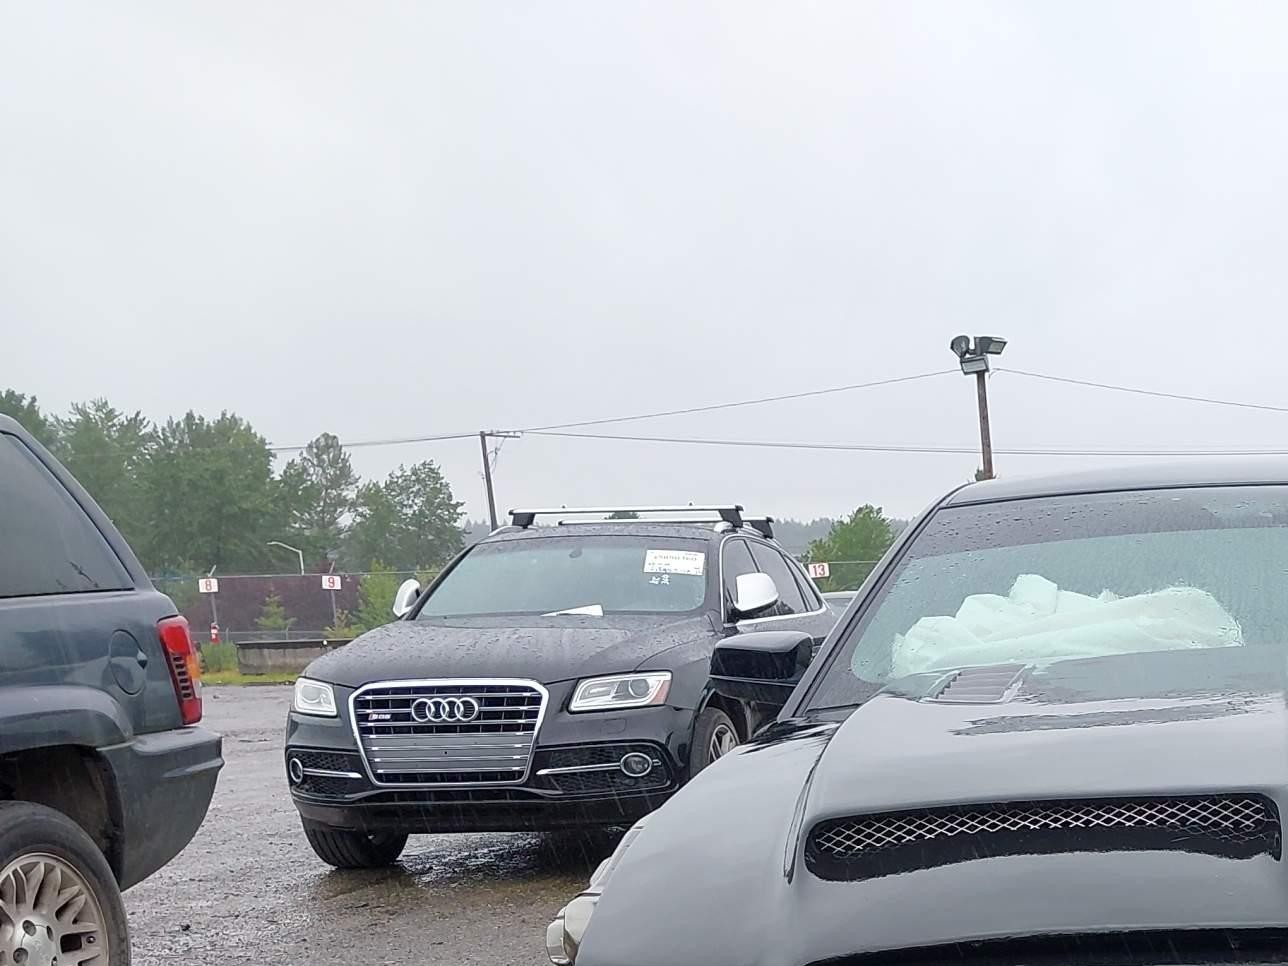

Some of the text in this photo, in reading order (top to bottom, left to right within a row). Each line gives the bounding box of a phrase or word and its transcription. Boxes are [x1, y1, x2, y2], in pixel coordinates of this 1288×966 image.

[813, 565, 826, 577] 13
[204, 579, 212, 591] 8
[327, 577, 336, 588] 9
